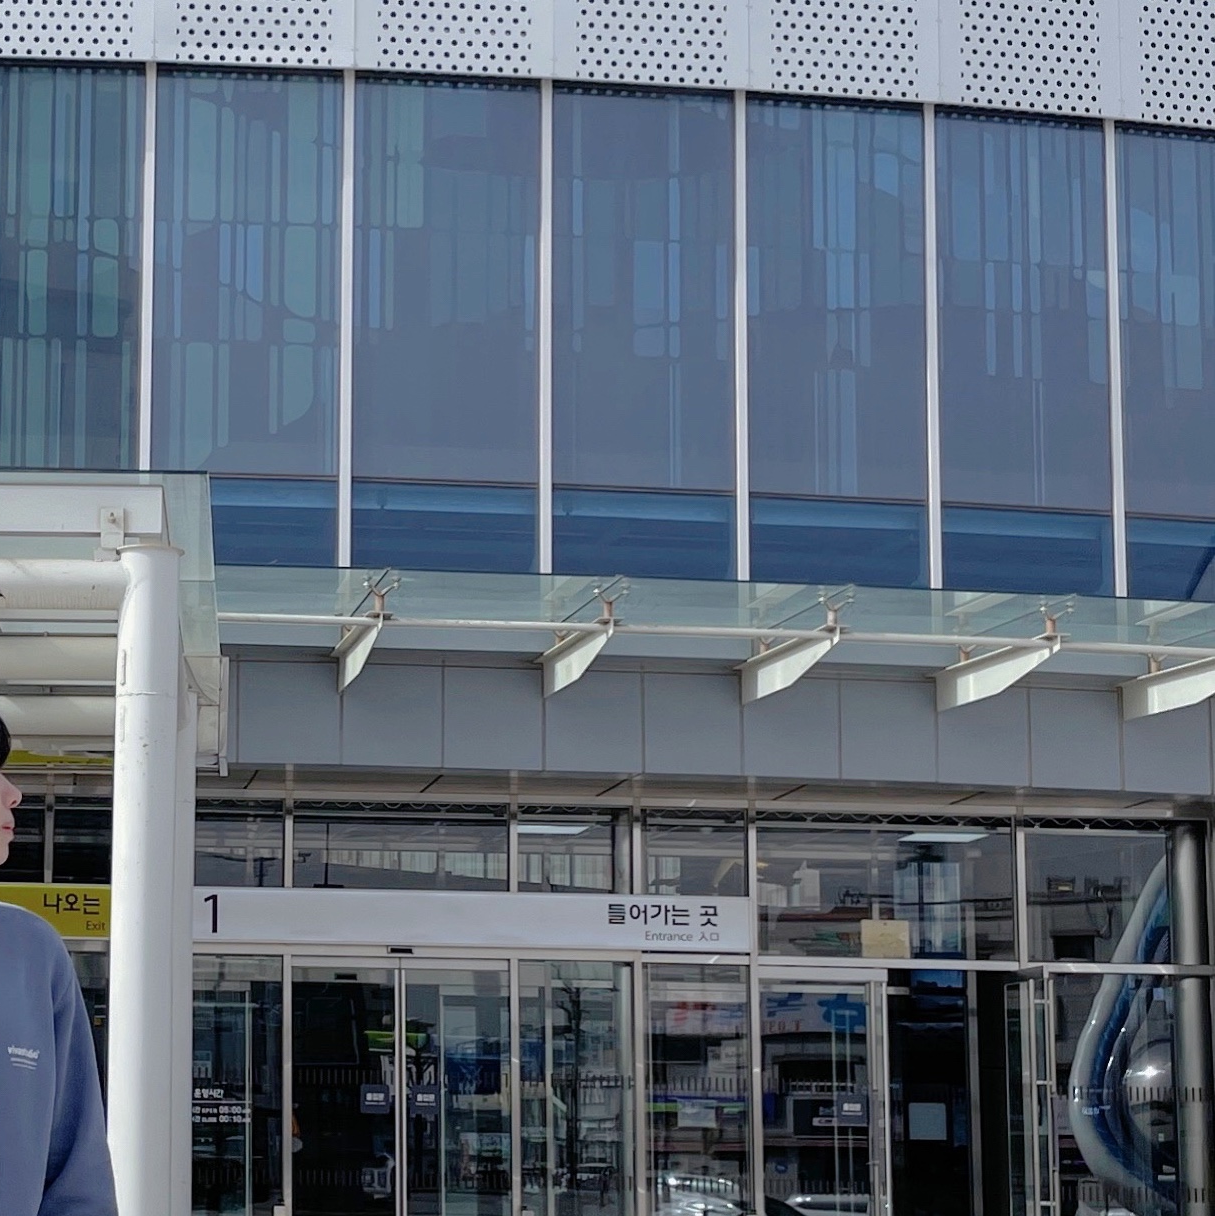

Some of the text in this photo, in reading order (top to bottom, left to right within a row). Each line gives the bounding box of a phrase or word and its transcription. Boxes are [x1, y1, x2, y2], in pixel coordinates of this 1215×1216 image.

[43, 893, 100, 915] 나오는
[204, 894, 218, 934] 1
[608, 903, 718, 927] 들어가는 곳
[86, 920, 106, 931] Exit
[645, 930, 694, 942] Entrance
